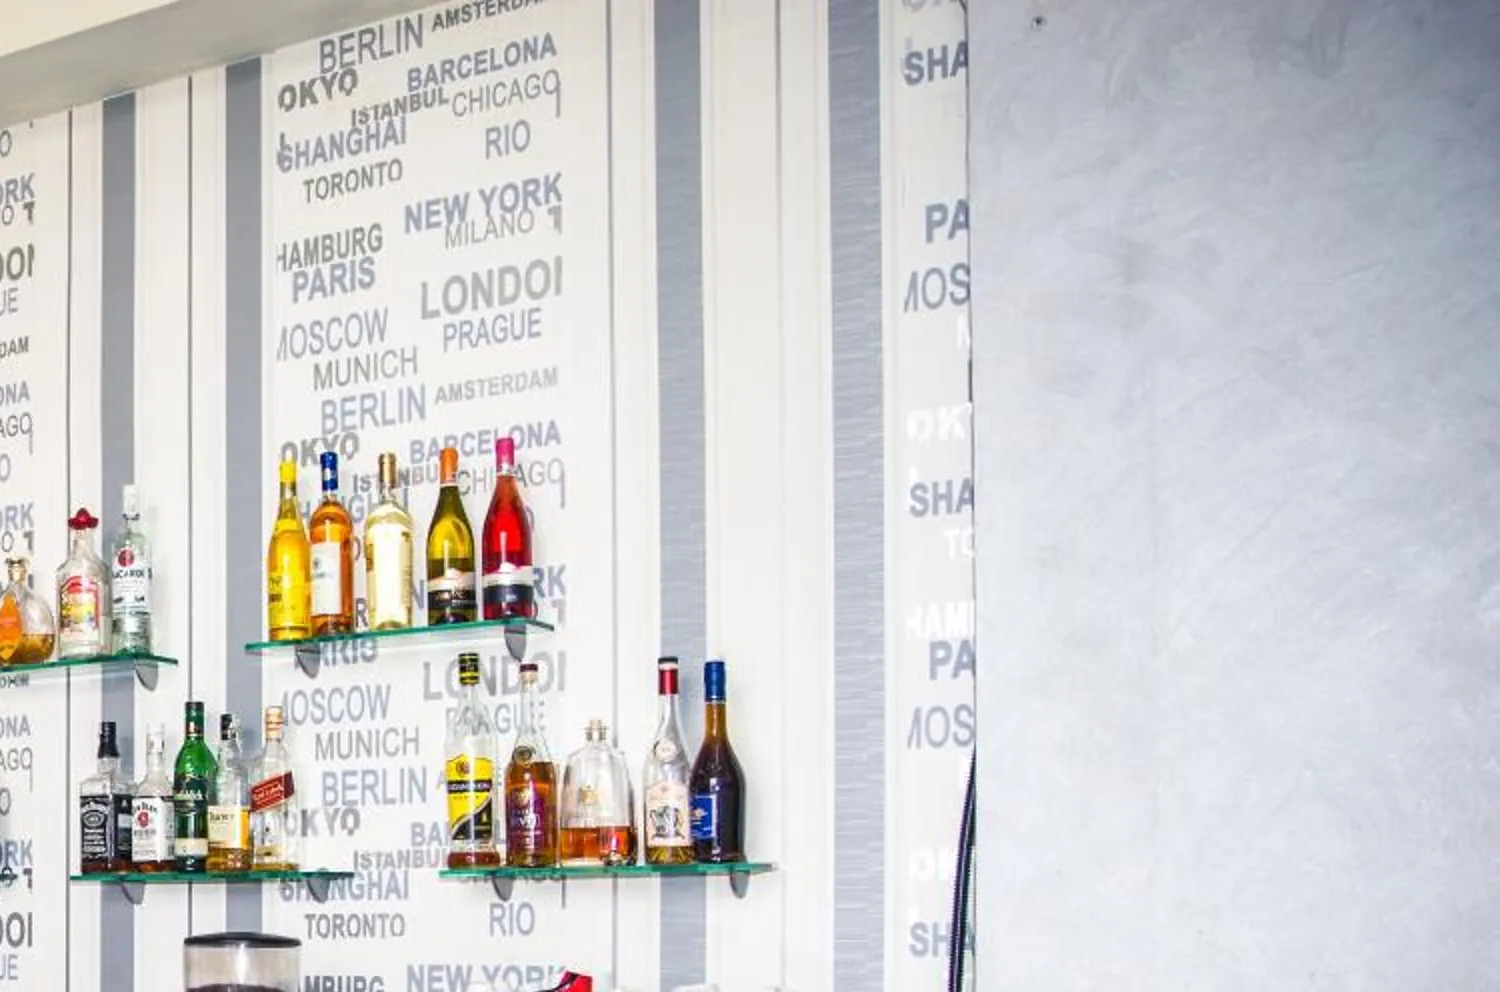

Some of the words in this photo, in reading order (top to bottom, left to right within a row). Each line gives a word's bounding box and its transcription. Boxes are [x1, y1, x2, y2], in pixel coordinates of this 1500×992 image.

[320, 15, 424, 74] BERLIN
[408, 32, 557, 93] BARCELONA
[351, 88, 450, 127] ISTANBUL
[452, 69, 561, 118] CHICAGO
[278, 118, 407, 173] SHANGHAI
[485, 119, 531, 161] RIO
[303, 158, 403, 204] TORONTO
[405, 192, 470, 235] NEW
[478, 173, 562, 219] YORK
[446, 207, 534, 251] MILANO
[292, 256, 375, 304] PARIS
[443, 307, 543, 353] PRAGUE
[313, 345, 418, 391] MUNICH
[435, 366, 559, 406] AMSTERDAM
[321, 384, 426, 435] BERLIN
[316, 727, 419, 761] MUNICH
[322, 767, 426, 806] BERLIN
[304, 913, 405, 939] TORONTO
[490, 902, 535, 937] RIO
